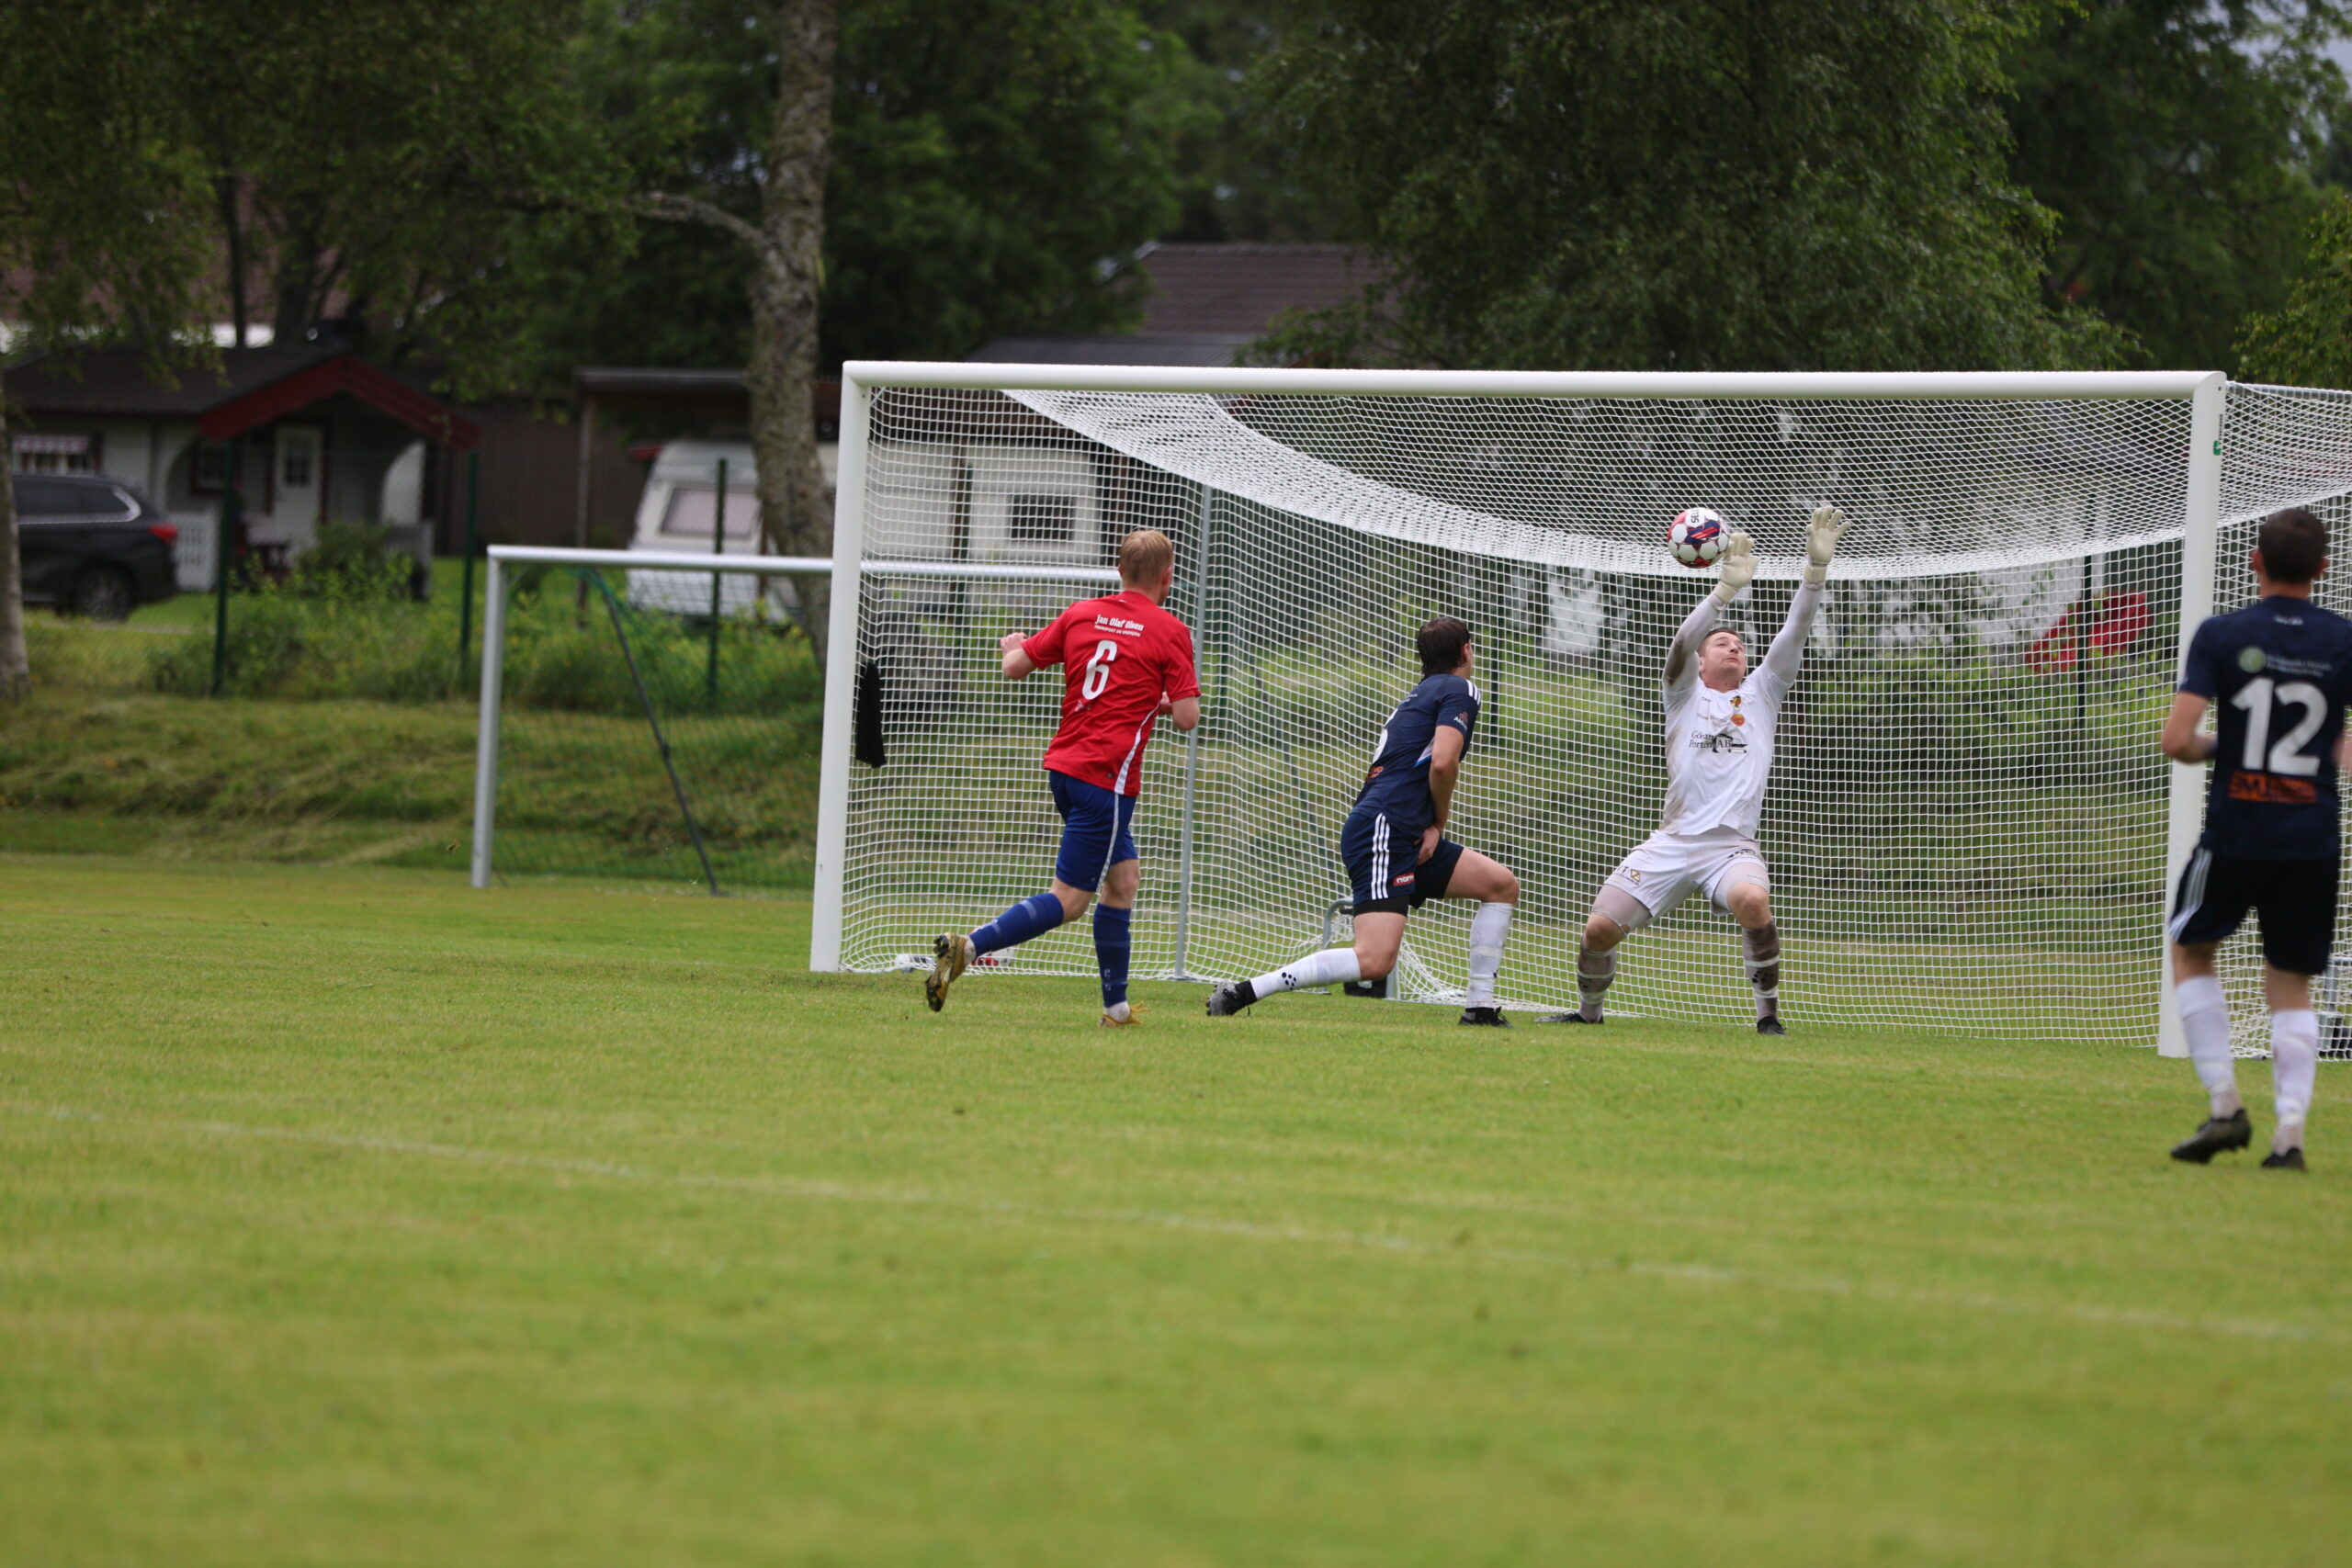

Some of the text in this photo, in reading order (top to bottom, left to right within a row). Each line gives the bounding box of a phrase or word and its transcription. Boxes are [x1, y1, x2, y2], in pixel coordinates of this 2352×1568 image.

[1094, 615, 1109, 625] Jan
[1109, 617, 1126, 628] Olaf
[1081, 639, 1118, 700] 6
[1718, 739, 1732, 749] AB
[2230, 677, 2329, 776] 12
